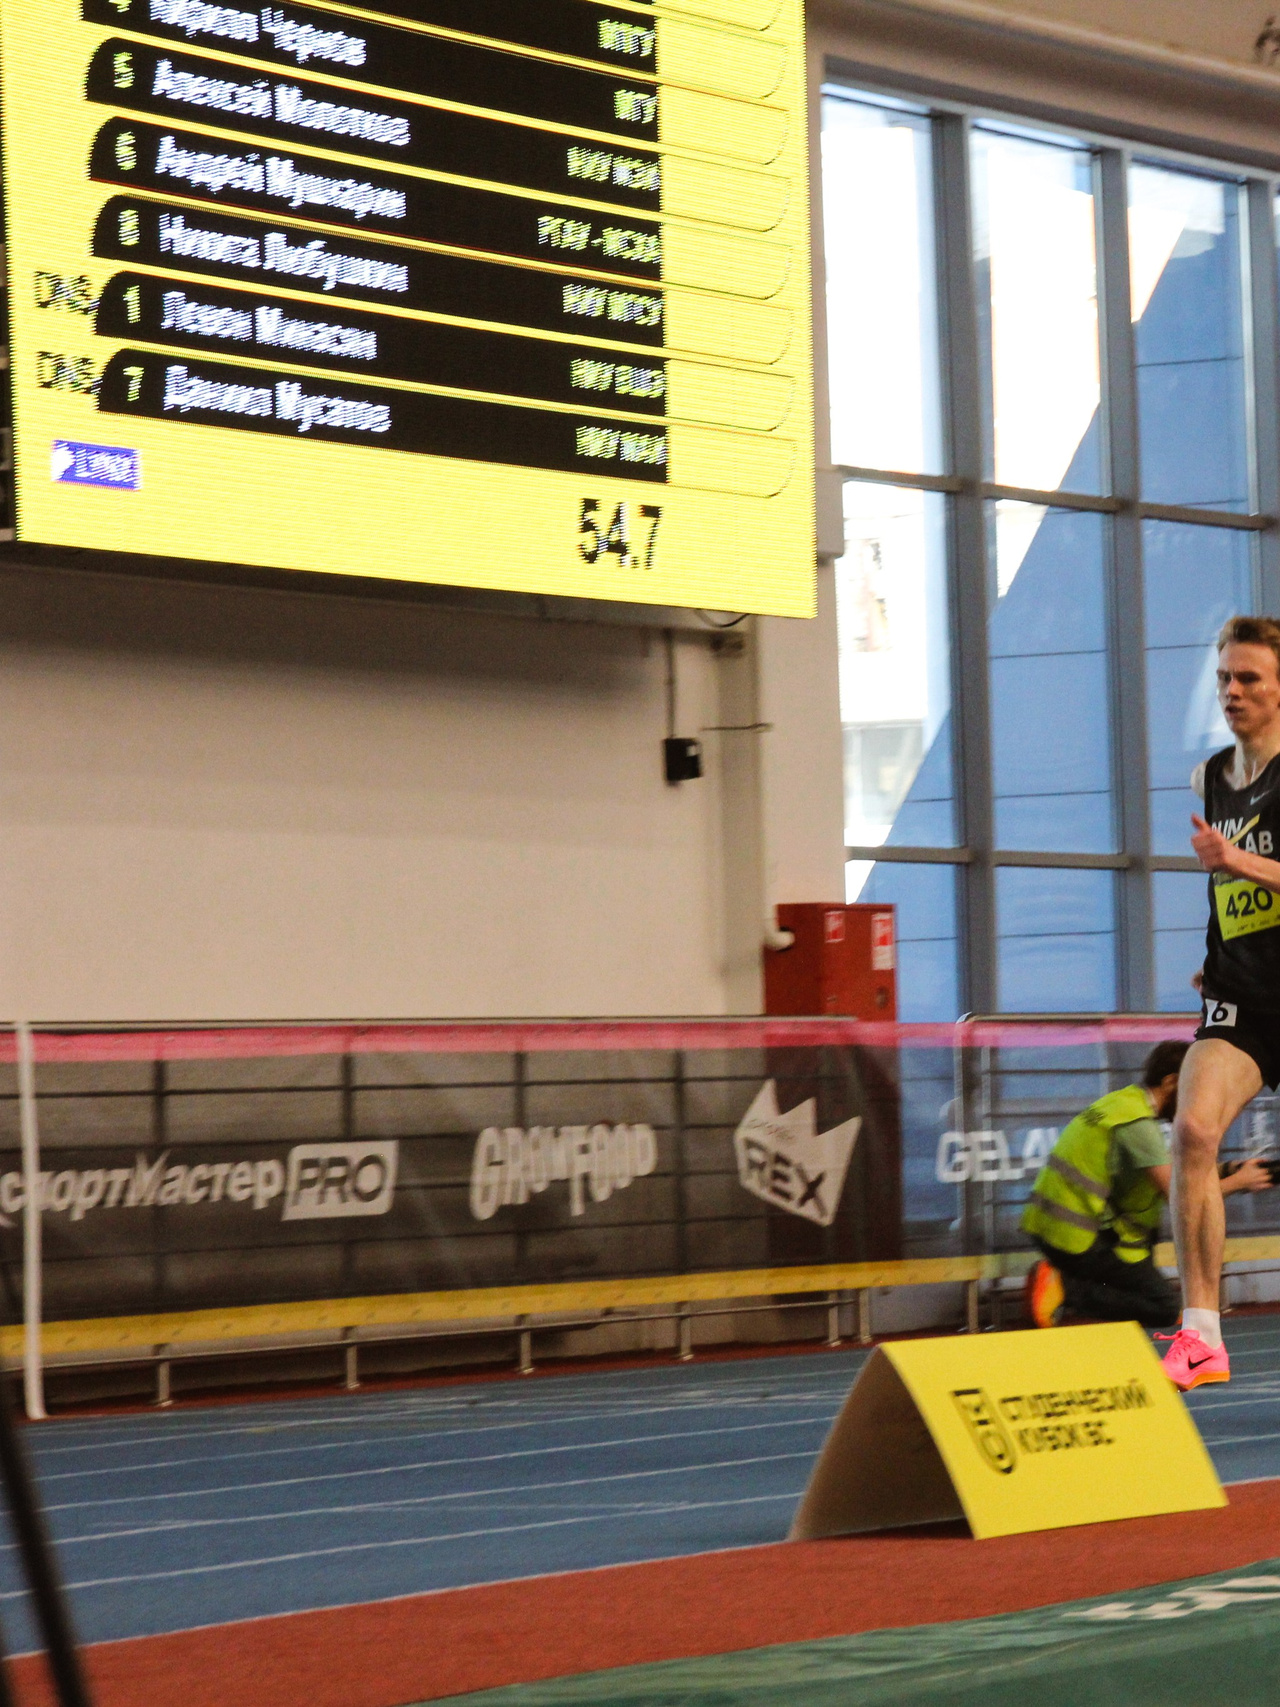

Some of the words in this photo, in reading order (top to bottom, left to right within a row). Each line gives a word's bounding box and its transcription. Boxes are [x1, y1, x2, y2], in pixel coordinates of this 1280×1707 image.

[152, 59, 272, 118] Алексей
[155, 135, 265, 193] Андрей
[159, 212, 262, 268] Никита
[577, 498, 662, 569] 54.7
[1226, 886, 1272, 919] 420
[1212, 1002, 1229, 1022] 6
[743, 1136, 828, 1218] REX
